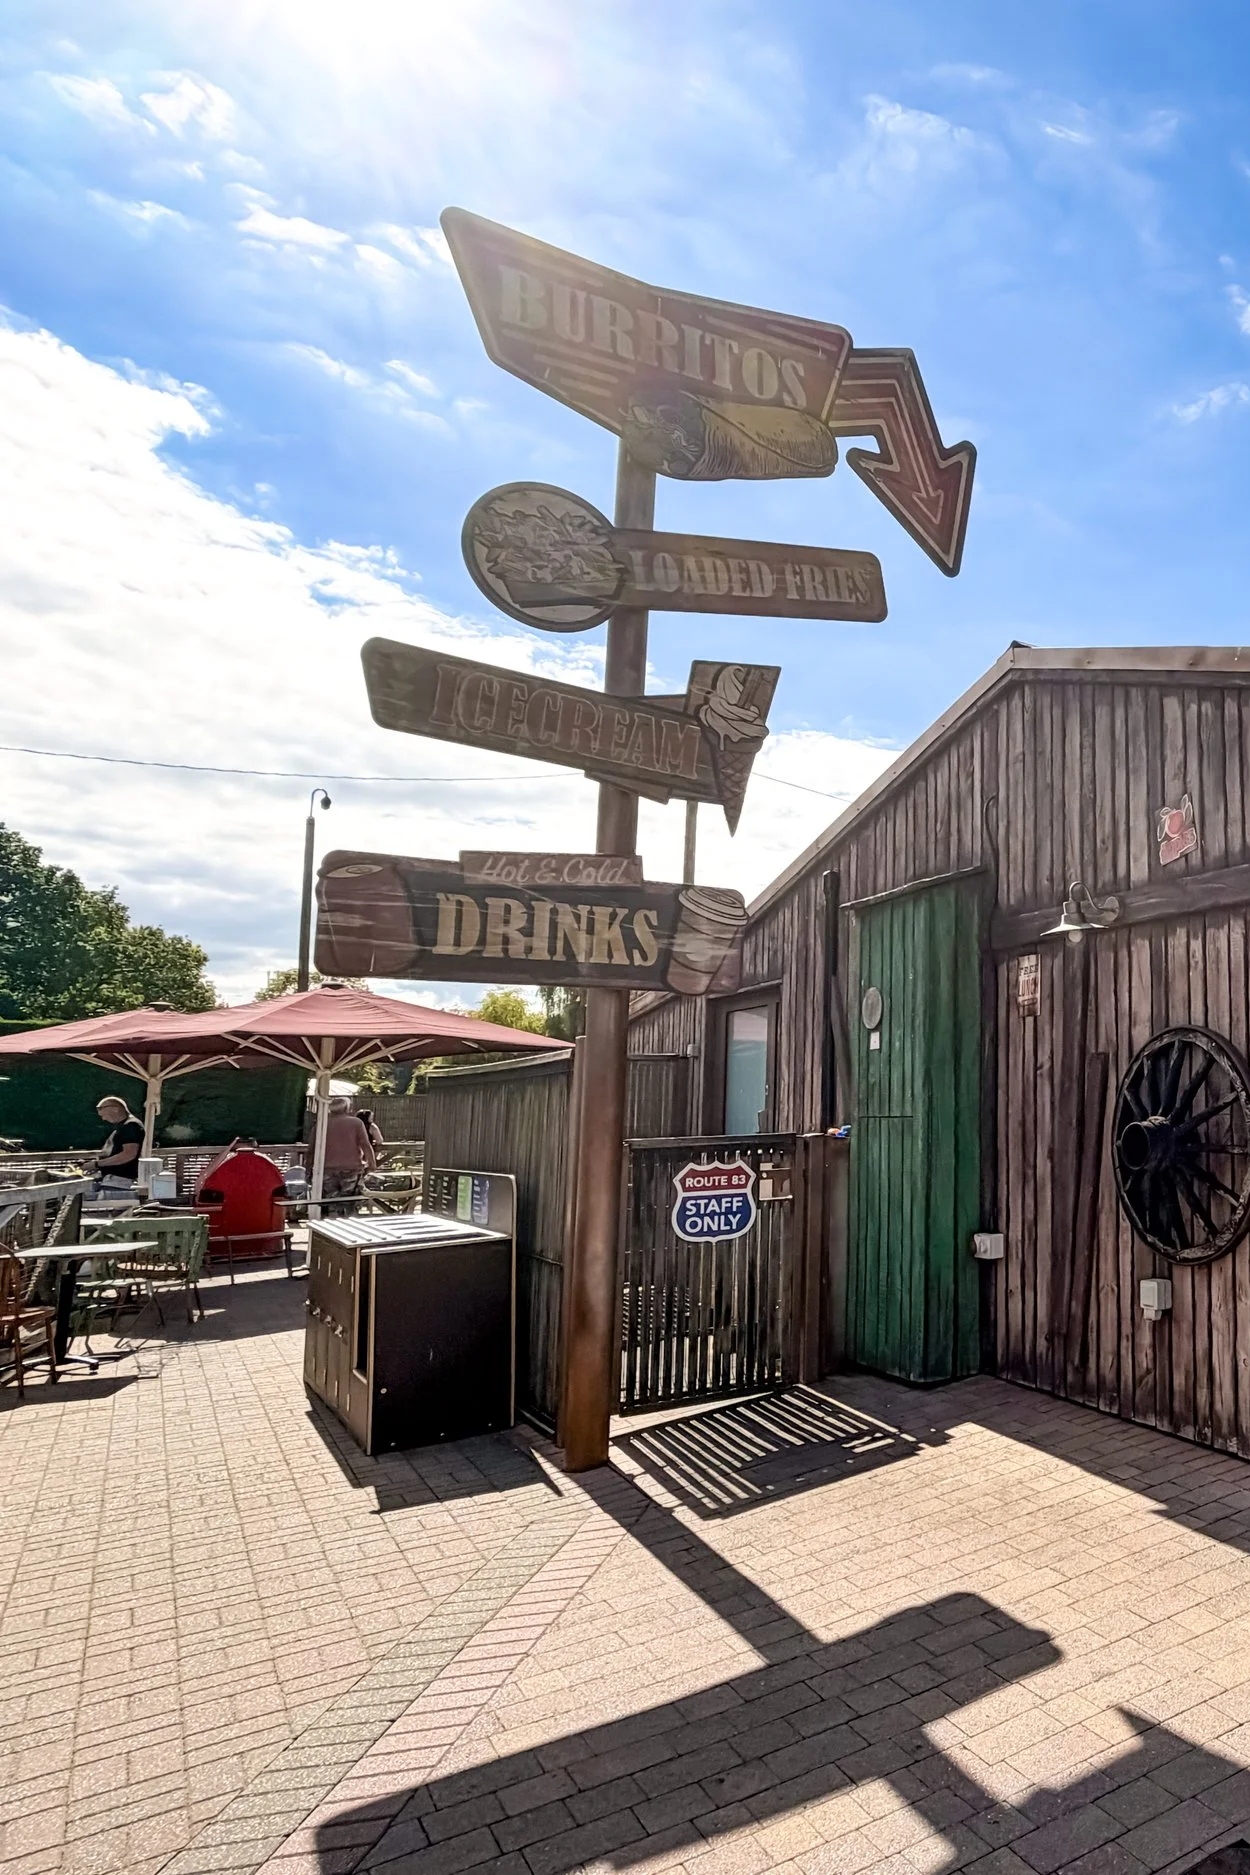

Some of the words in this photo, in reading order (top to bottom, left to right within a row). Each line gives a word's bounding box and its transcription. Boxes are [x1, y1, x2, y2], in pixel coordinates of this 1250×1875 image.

[499, 263, 808, 410] BURRITOS
[627, 549, 777, 599] LOADED
[784, 561, 874, 605] FRIES
[480, 855, 530, 883] Hot
[535, 856, 557, 883] &
[563, 857, 630, 884] Cold
[432, 892, 659, 967] DRINKS
[685, 1175, 728, 1188] ROUTE
[731, 1174, 746, 1185] 83
[685, 1196, 743, 1215] STAFF
[684, 1213, 742, 1234] ONLY
